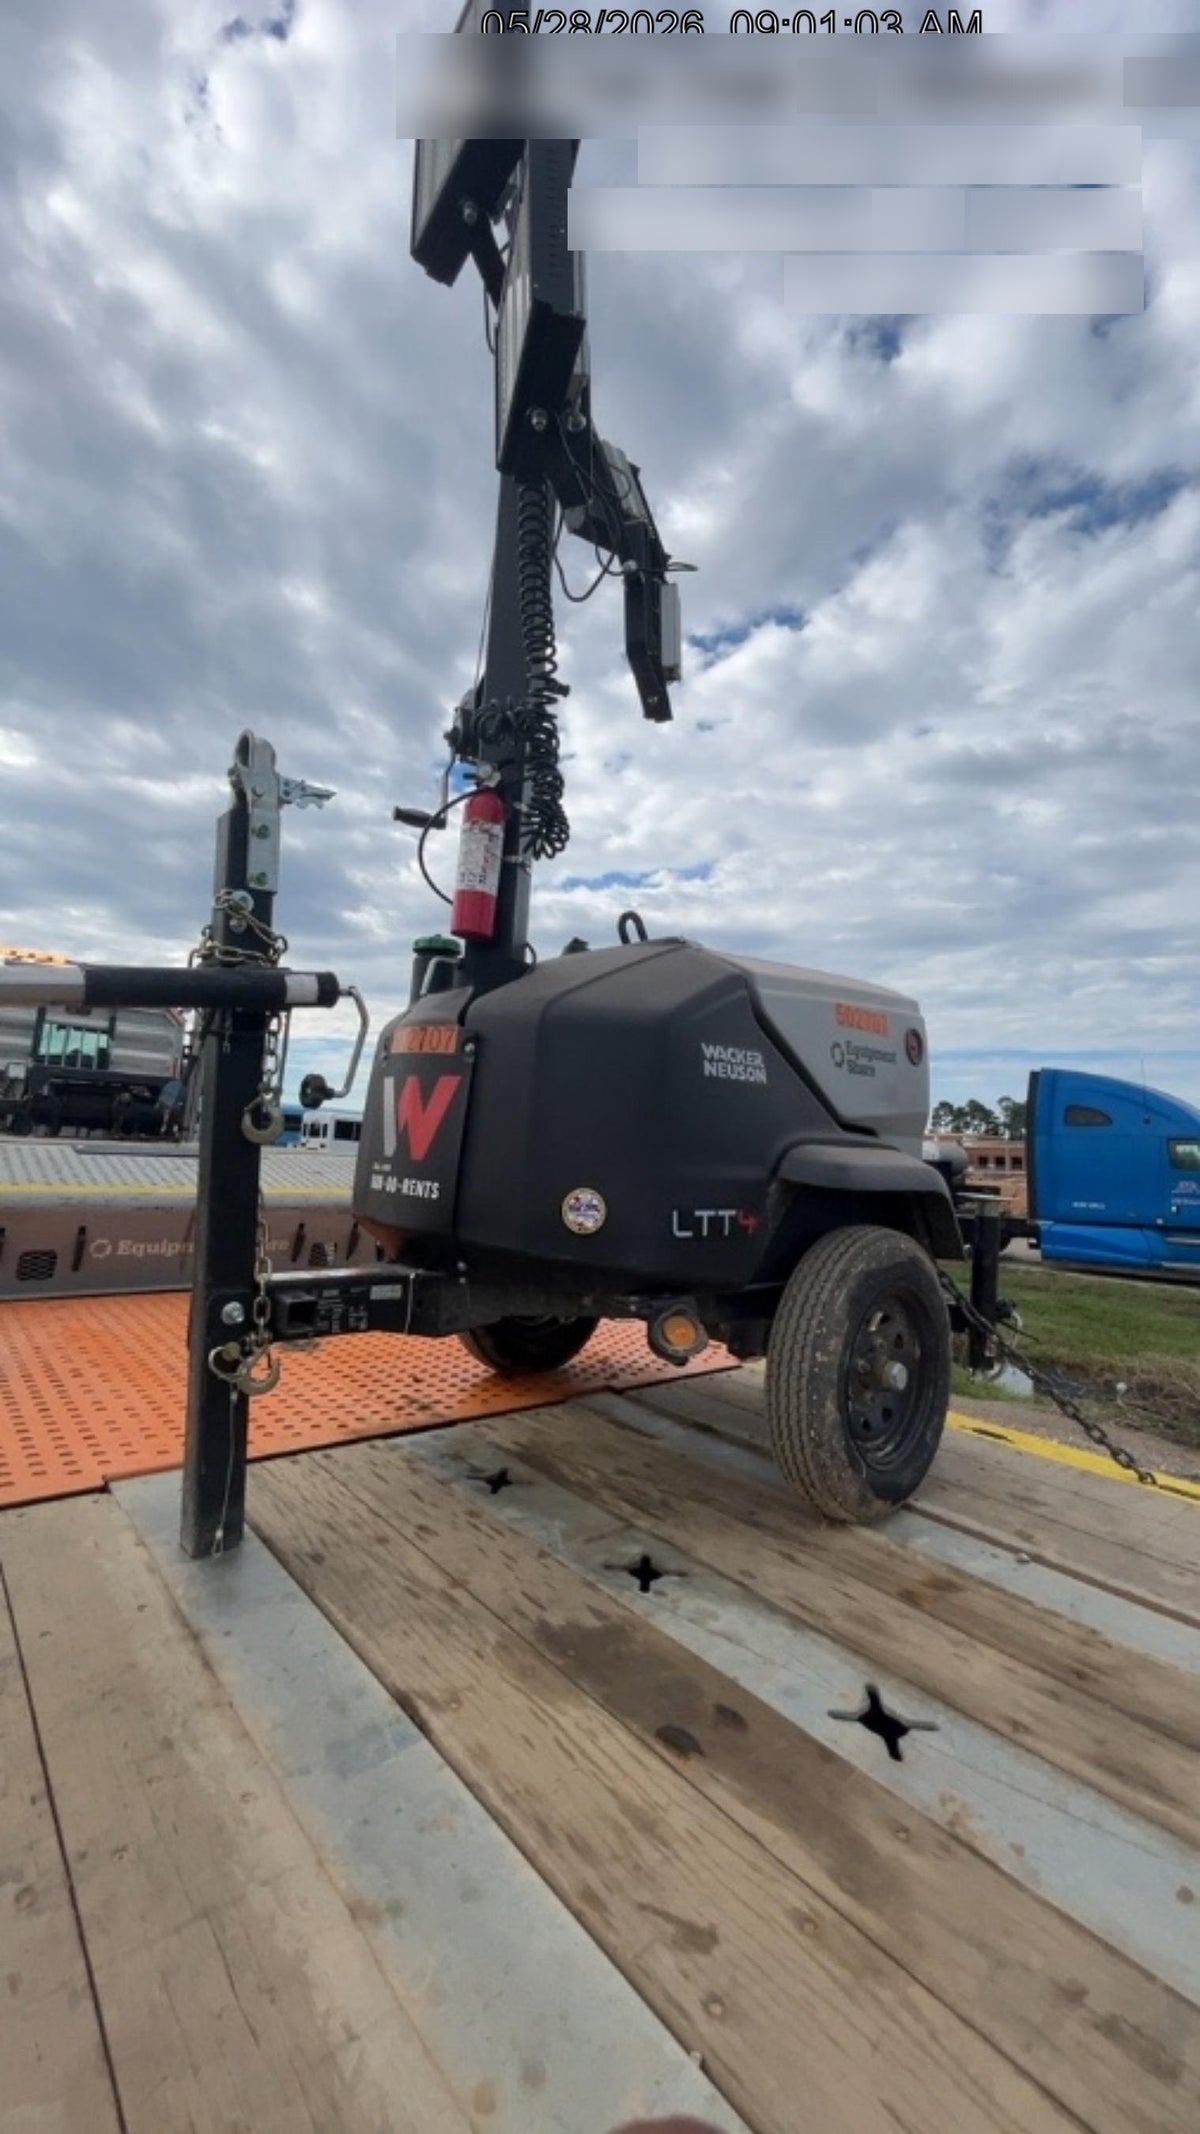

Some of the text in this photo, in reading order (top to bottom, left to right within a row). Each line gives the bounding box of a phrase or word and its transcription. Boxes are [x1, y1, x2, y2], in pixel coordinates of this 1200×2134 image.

[701, 1042, 764, 1069] WACKER
[704, 1059, 767, 1085] NEUSON
[673, 1209, 761, 1238] LTT4
